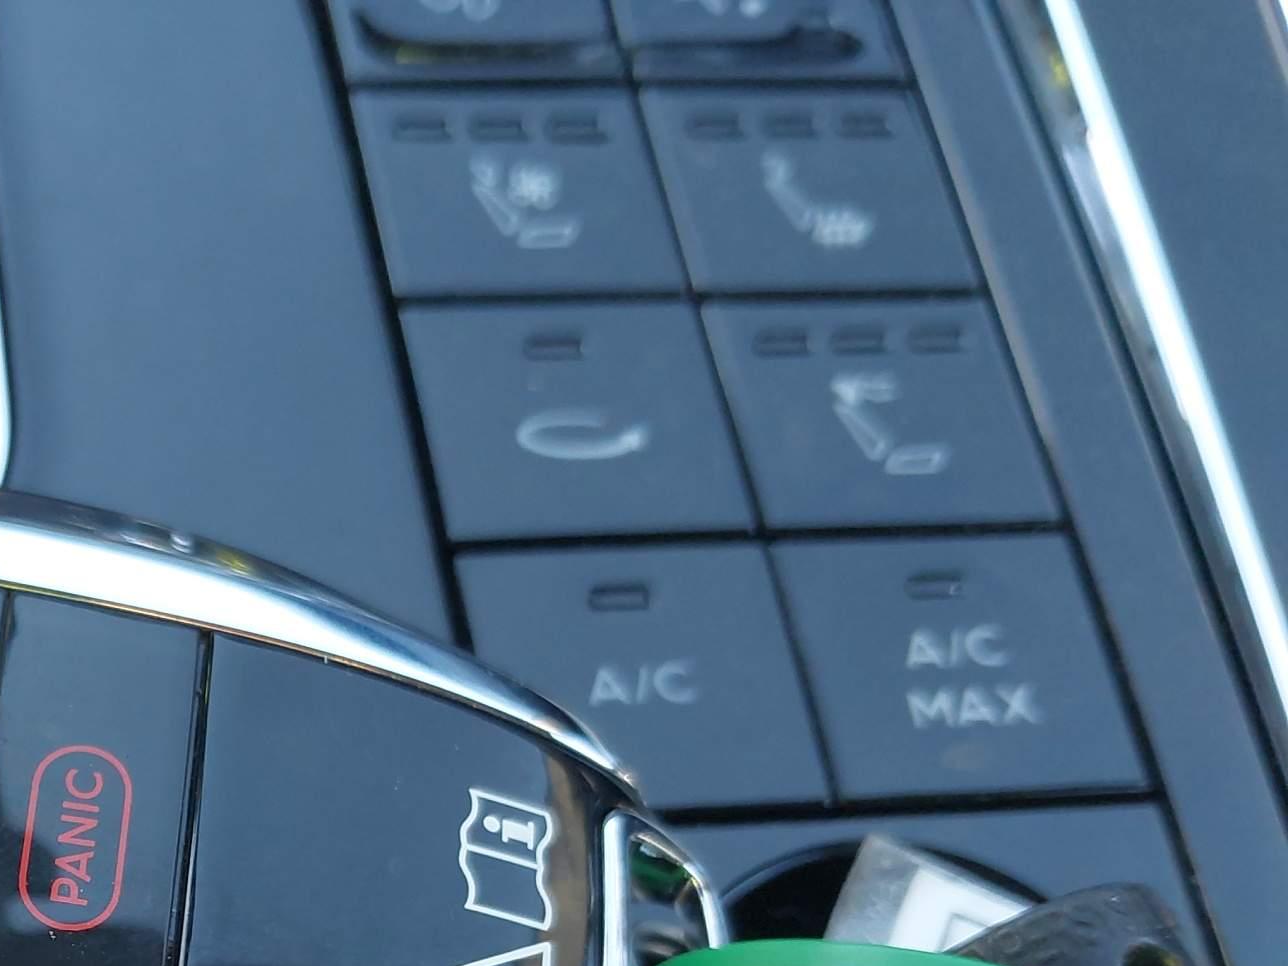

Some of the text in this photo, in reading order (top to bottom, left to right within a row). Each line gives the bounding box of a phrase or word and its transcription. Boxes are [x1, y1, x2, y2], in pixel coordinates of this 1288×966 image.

[905, 624, 1010, 668] A/C
[588, 662, 700, 706] A/C
[907, 684, 1044, 728] MAX
[48, 767, 105, 907] PANIC
